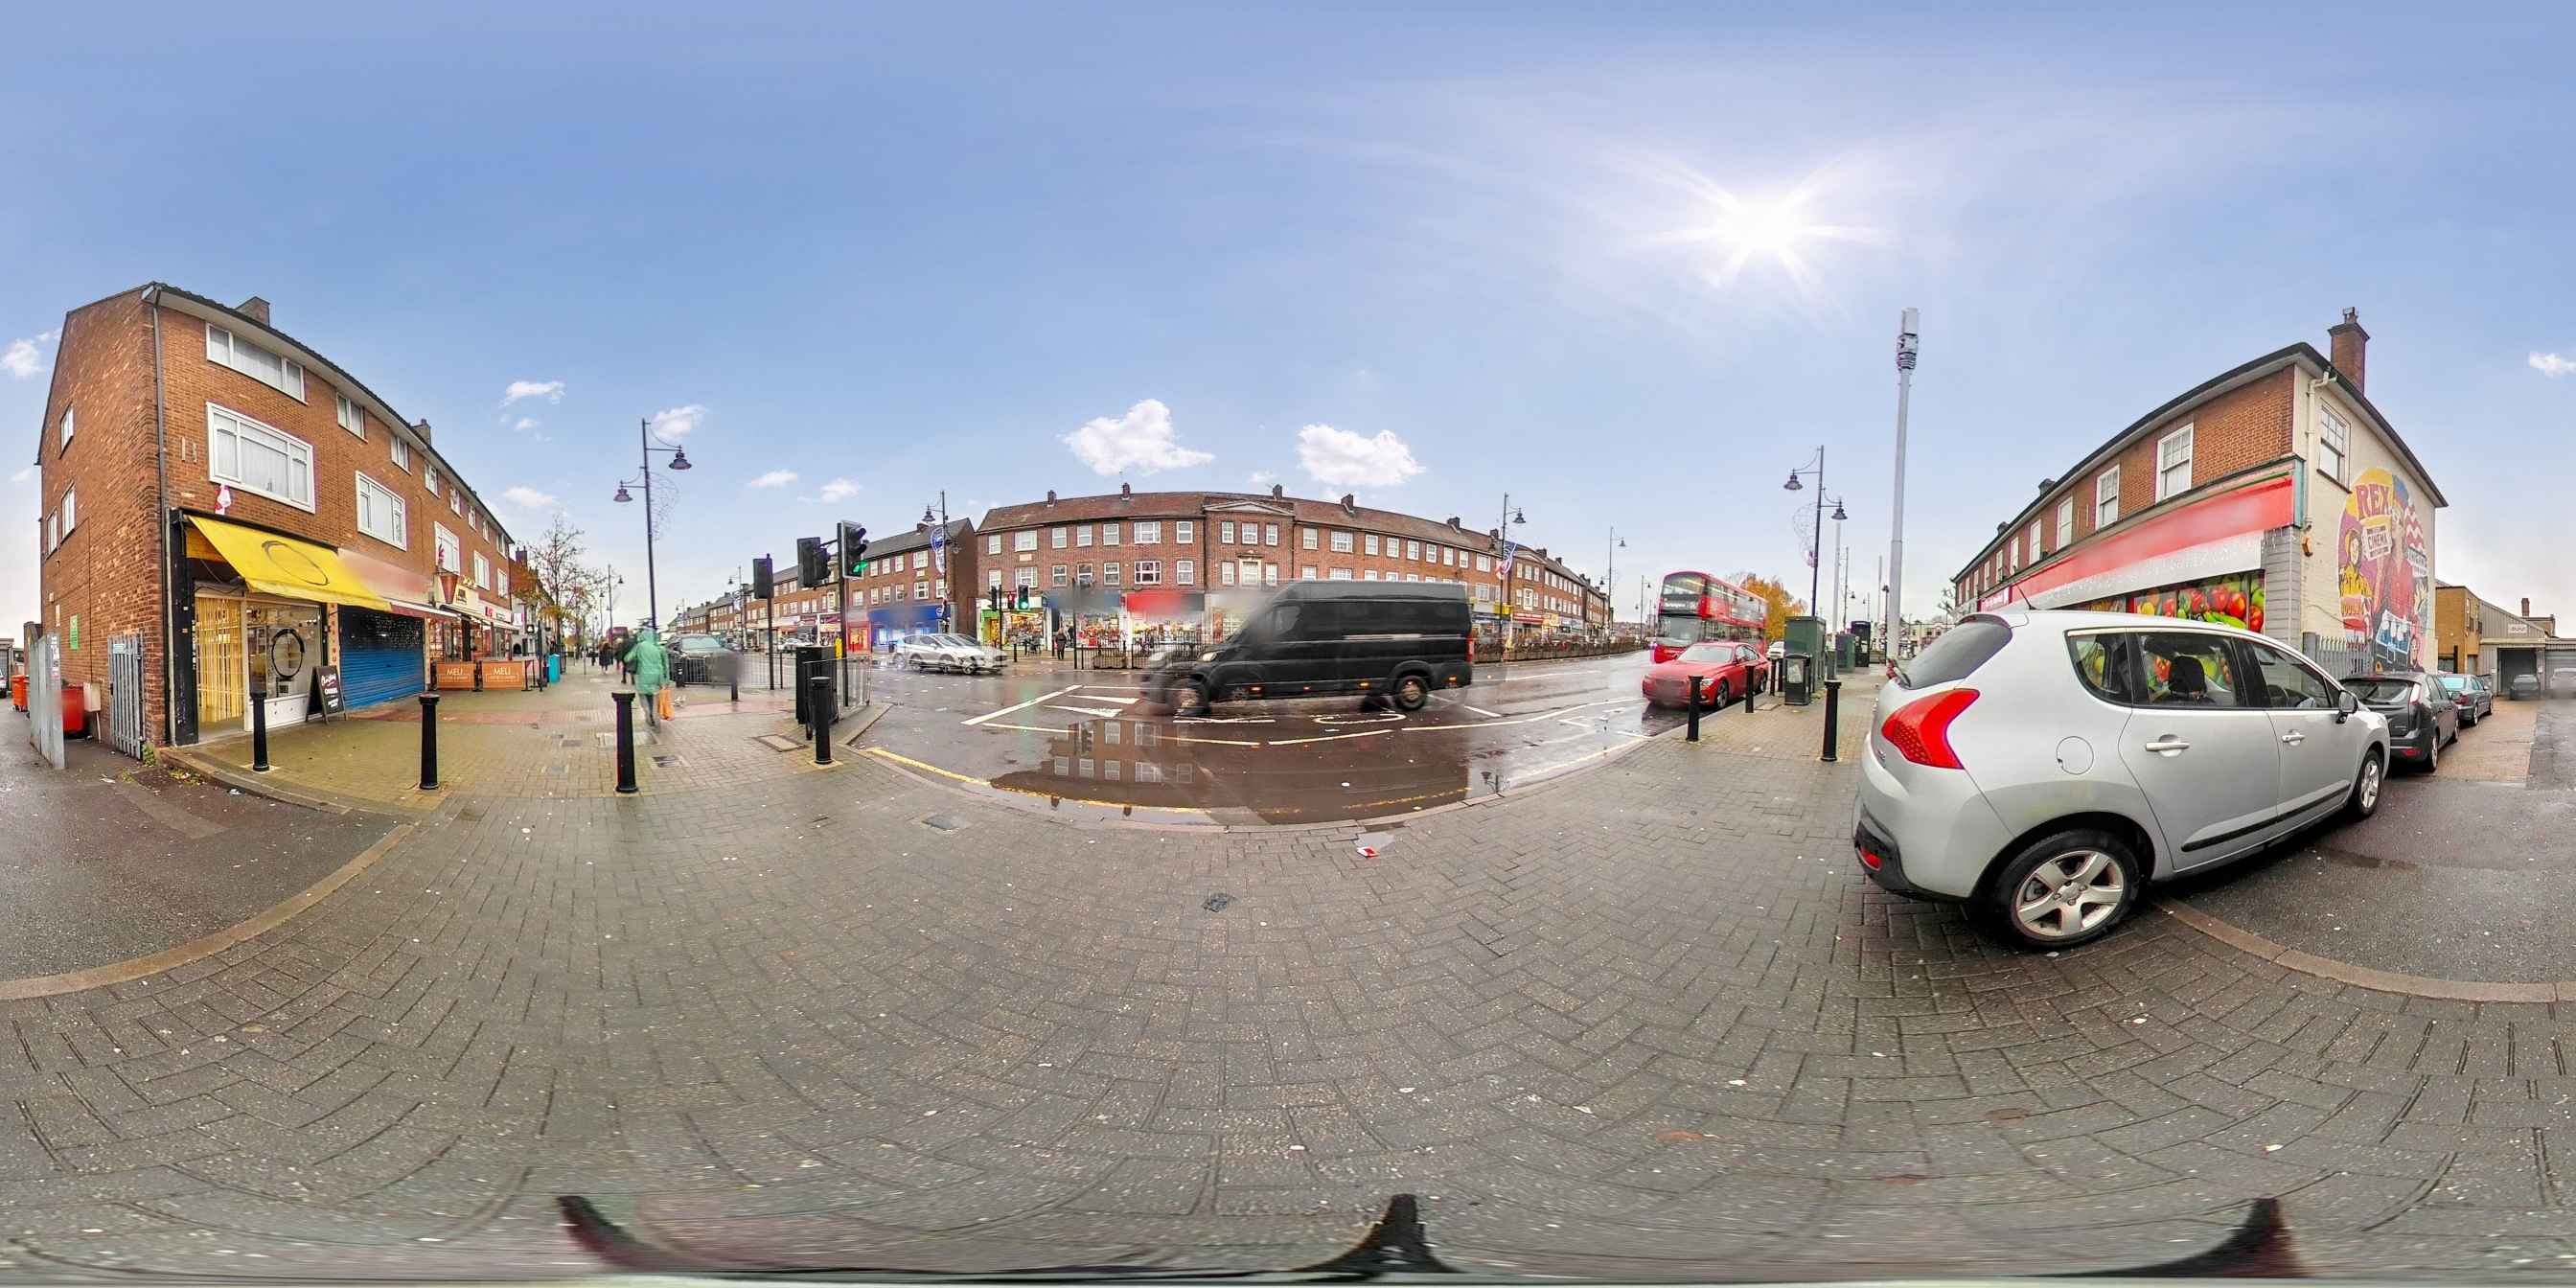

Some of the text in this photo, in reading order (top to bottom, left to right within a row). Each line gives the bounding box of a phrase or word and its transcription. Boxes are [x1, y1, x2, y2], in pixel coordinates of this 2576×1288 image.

[2356, 484, 2391, 517] REX
[2367, 532, 2388, 549] CINEMA
[493, 666, 511, 675] MELI
